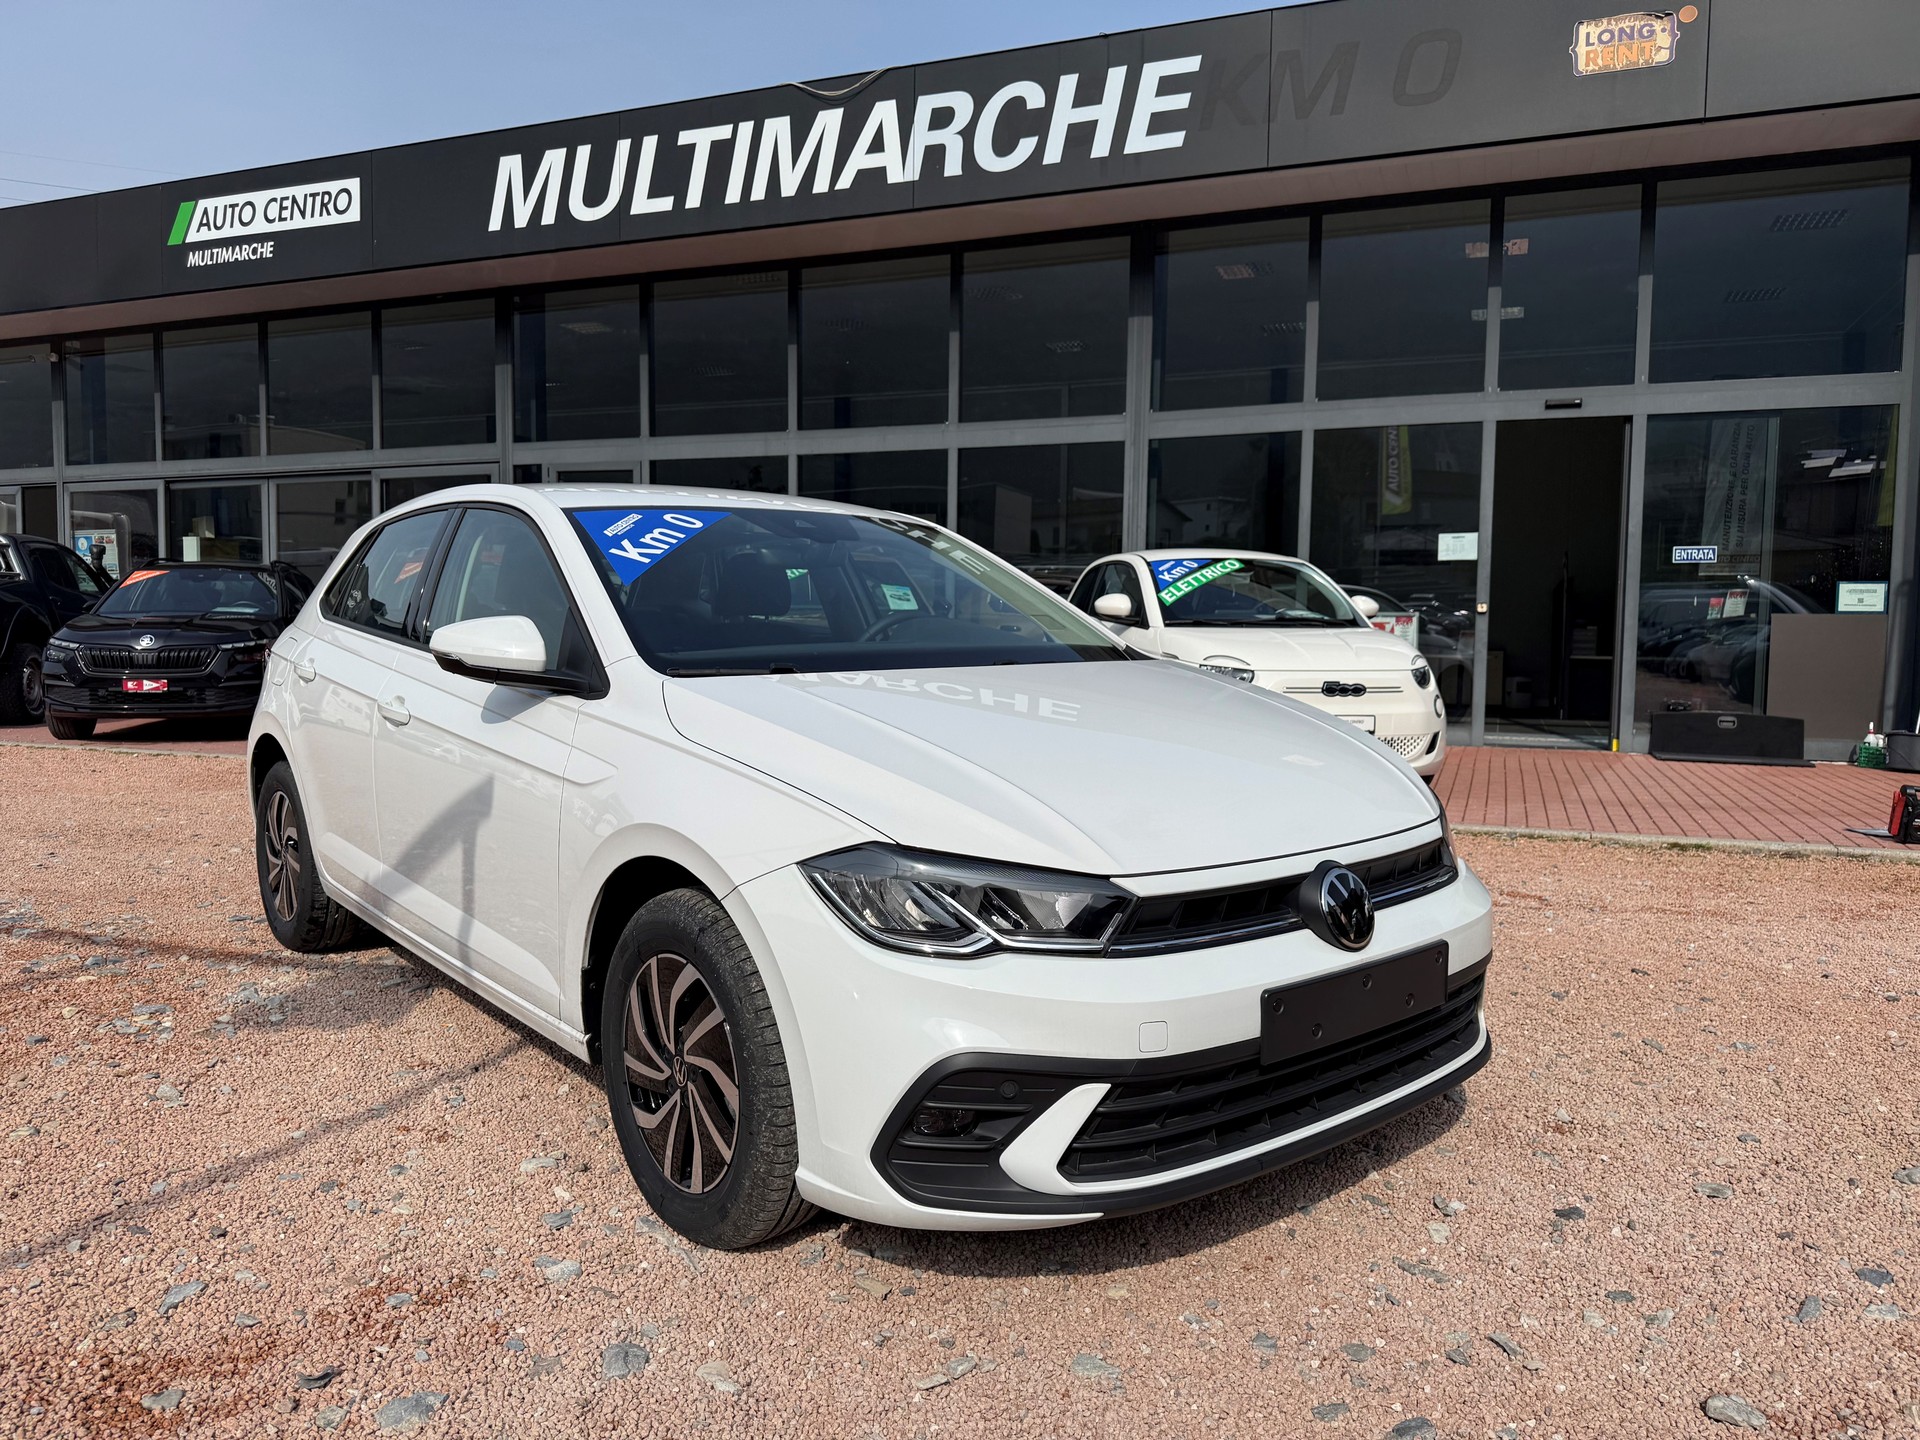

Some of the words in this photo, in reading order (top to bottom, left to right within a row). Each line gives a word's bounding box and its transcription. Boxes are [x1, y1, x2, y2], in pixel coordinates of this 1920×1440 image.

[1585, 23, 1656, 47] LONG
[1584, 40, 1655, 68] RENT
[488, 55, 1202, 233] MULTIMARCHE
[196, 201, 256, 234] AUTO
[263, 187, 353, 224] CENTRO
[187, 241, 274, 268] MULTIMARCHE
[1388, 426, 1399, 455] CEN
[608, 527, 687, 564] Km
[1675, 549, 1715, 560] ENTRATA
[1158, 566, 1190, 582] Km
[1161, 560, 1240, 603] ELETTRICO
[1321, 681, 1367, 697] 500
